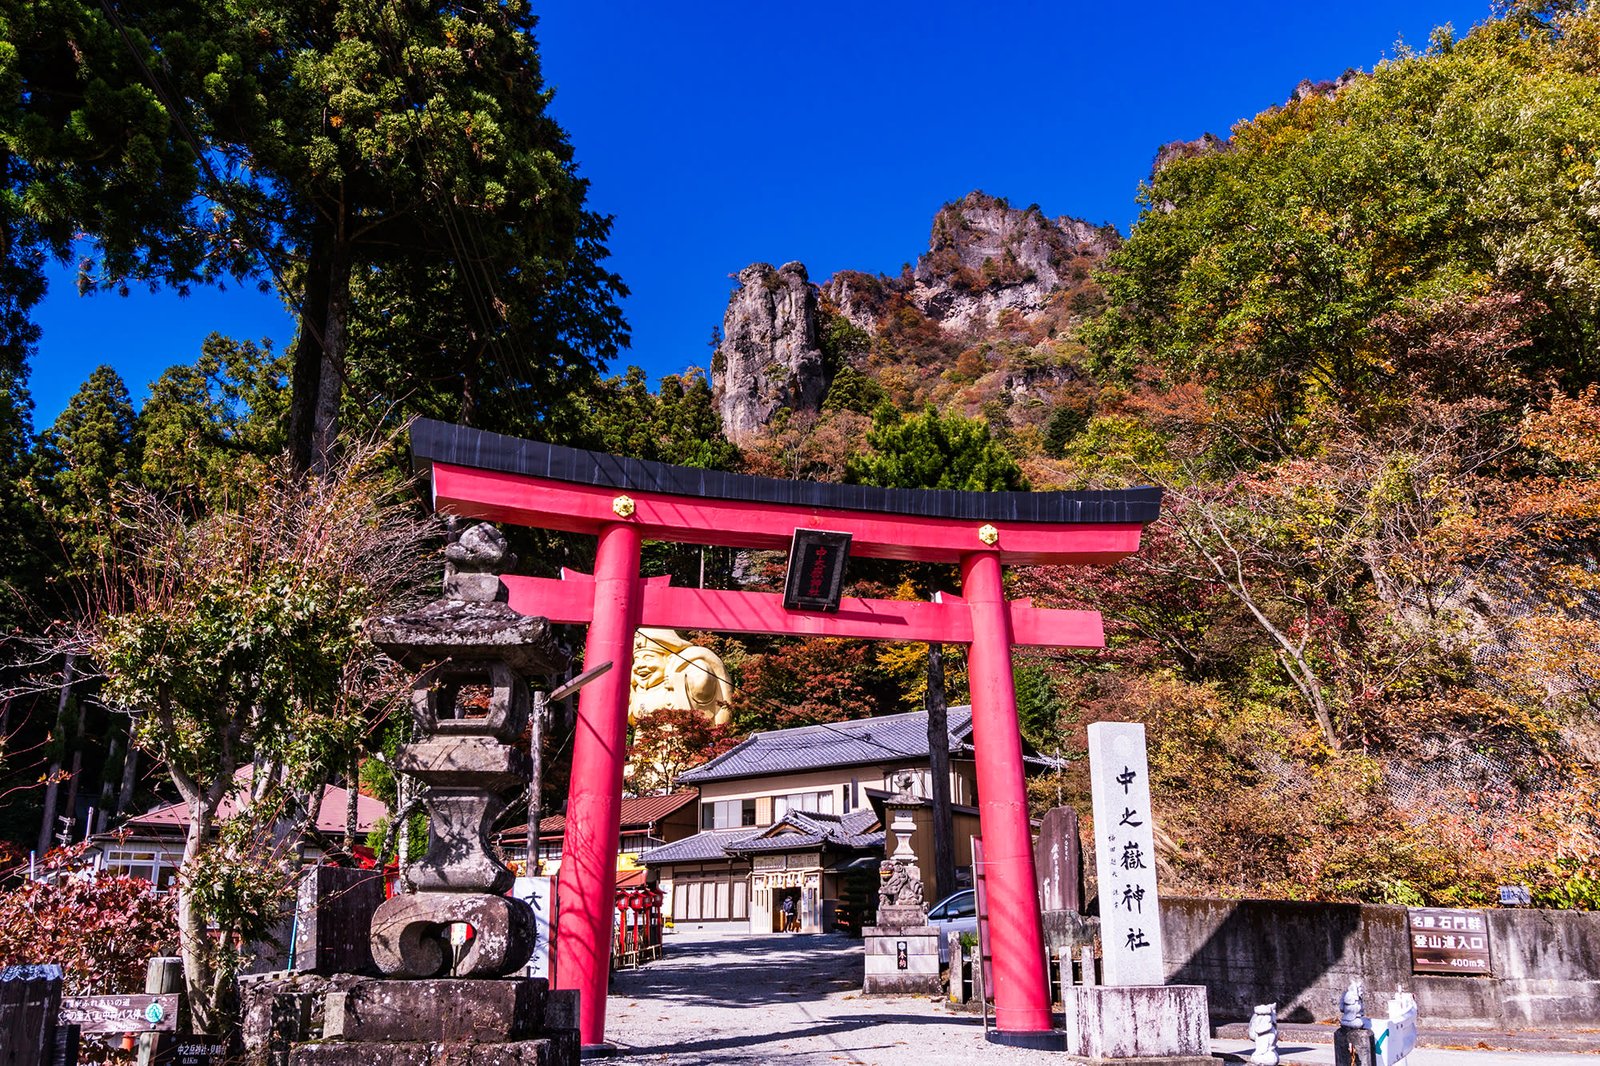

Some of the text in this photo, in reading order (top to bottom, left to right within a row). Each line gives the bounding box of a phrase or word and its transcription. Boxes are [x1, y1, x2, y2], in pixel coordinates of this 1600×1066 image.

[1116, 765, 1151, 951] 中之嶽神社
[1412, 916, 1482, 930] 名勝 石門群
[1414, 934, 1484, 950] 登山道入口
[1450, 958, 1486, 968] 400m先
